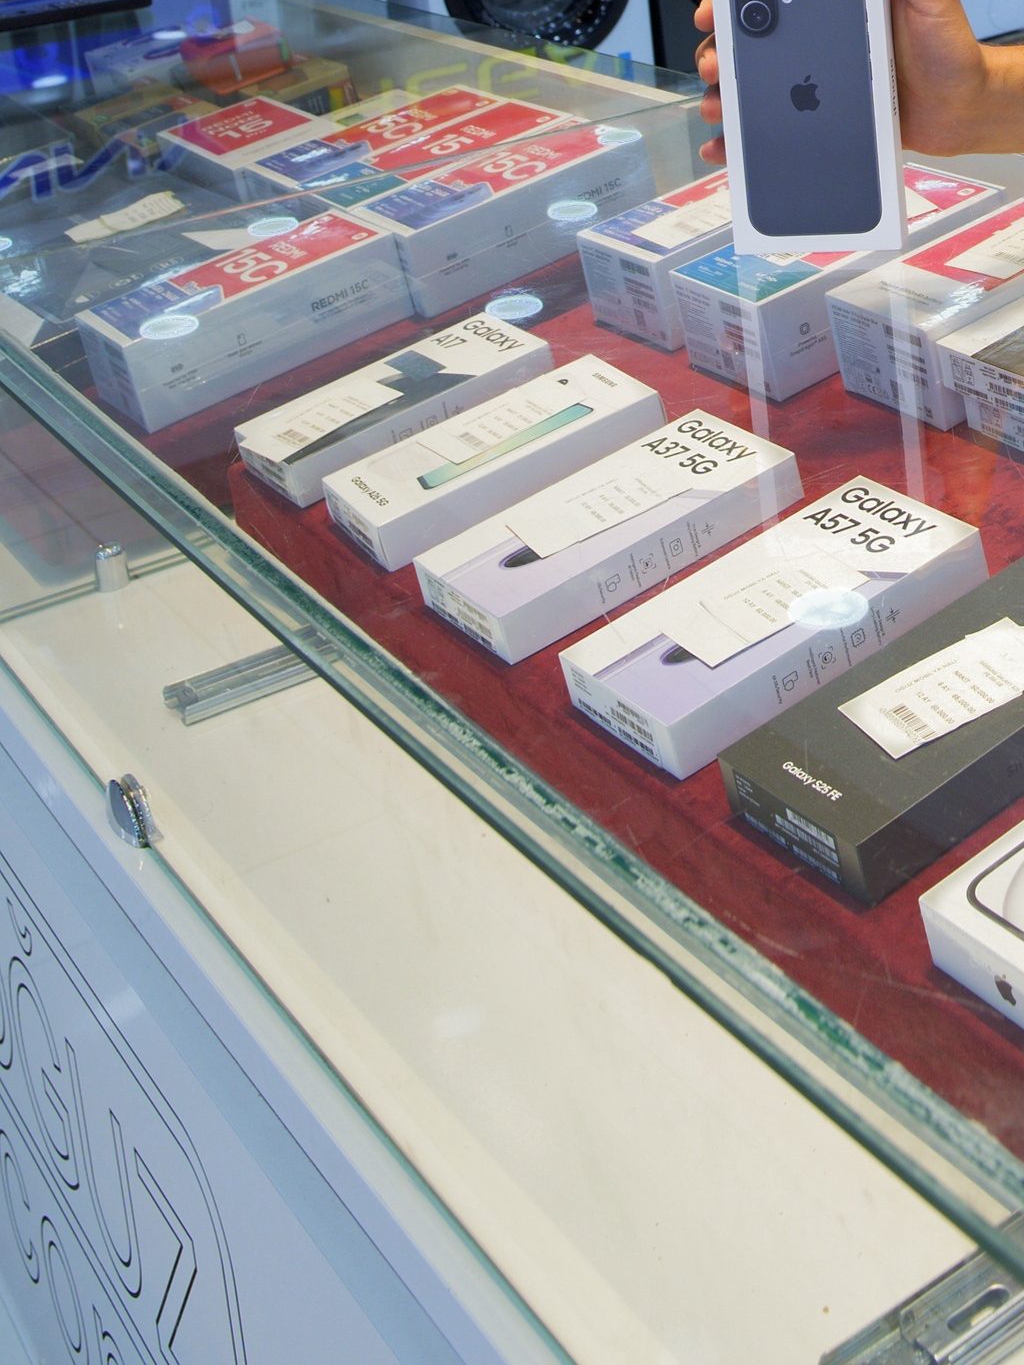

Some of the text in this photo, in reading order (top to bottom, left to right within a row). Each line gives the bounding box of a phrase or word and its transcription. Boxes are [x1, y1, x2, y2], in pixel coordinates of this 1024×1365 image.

[423, 134, 475, 156] 15
[478, 150, 550, 181] 15C
[215, 248, 289, 283] 15C
[267, 241, 308, 260] REDMI
[310, 279, 370, 313] REDMI 15C
[431, 333, 468, 350] A17
[462, 319, 524, 352] Galaxy
[592, 372, 618, 388] SAMSUNG
[641, 436, 719, 475] A37 5G
[677, 418, 757, 462] Galaxy
[351, 476, 371, 496] Galaxy
[841, 486, 937, 538] Galaxy
[803, 507, 896, 553] A57 5G
[782, 760, 844, 802] Galaxy S25 FE
